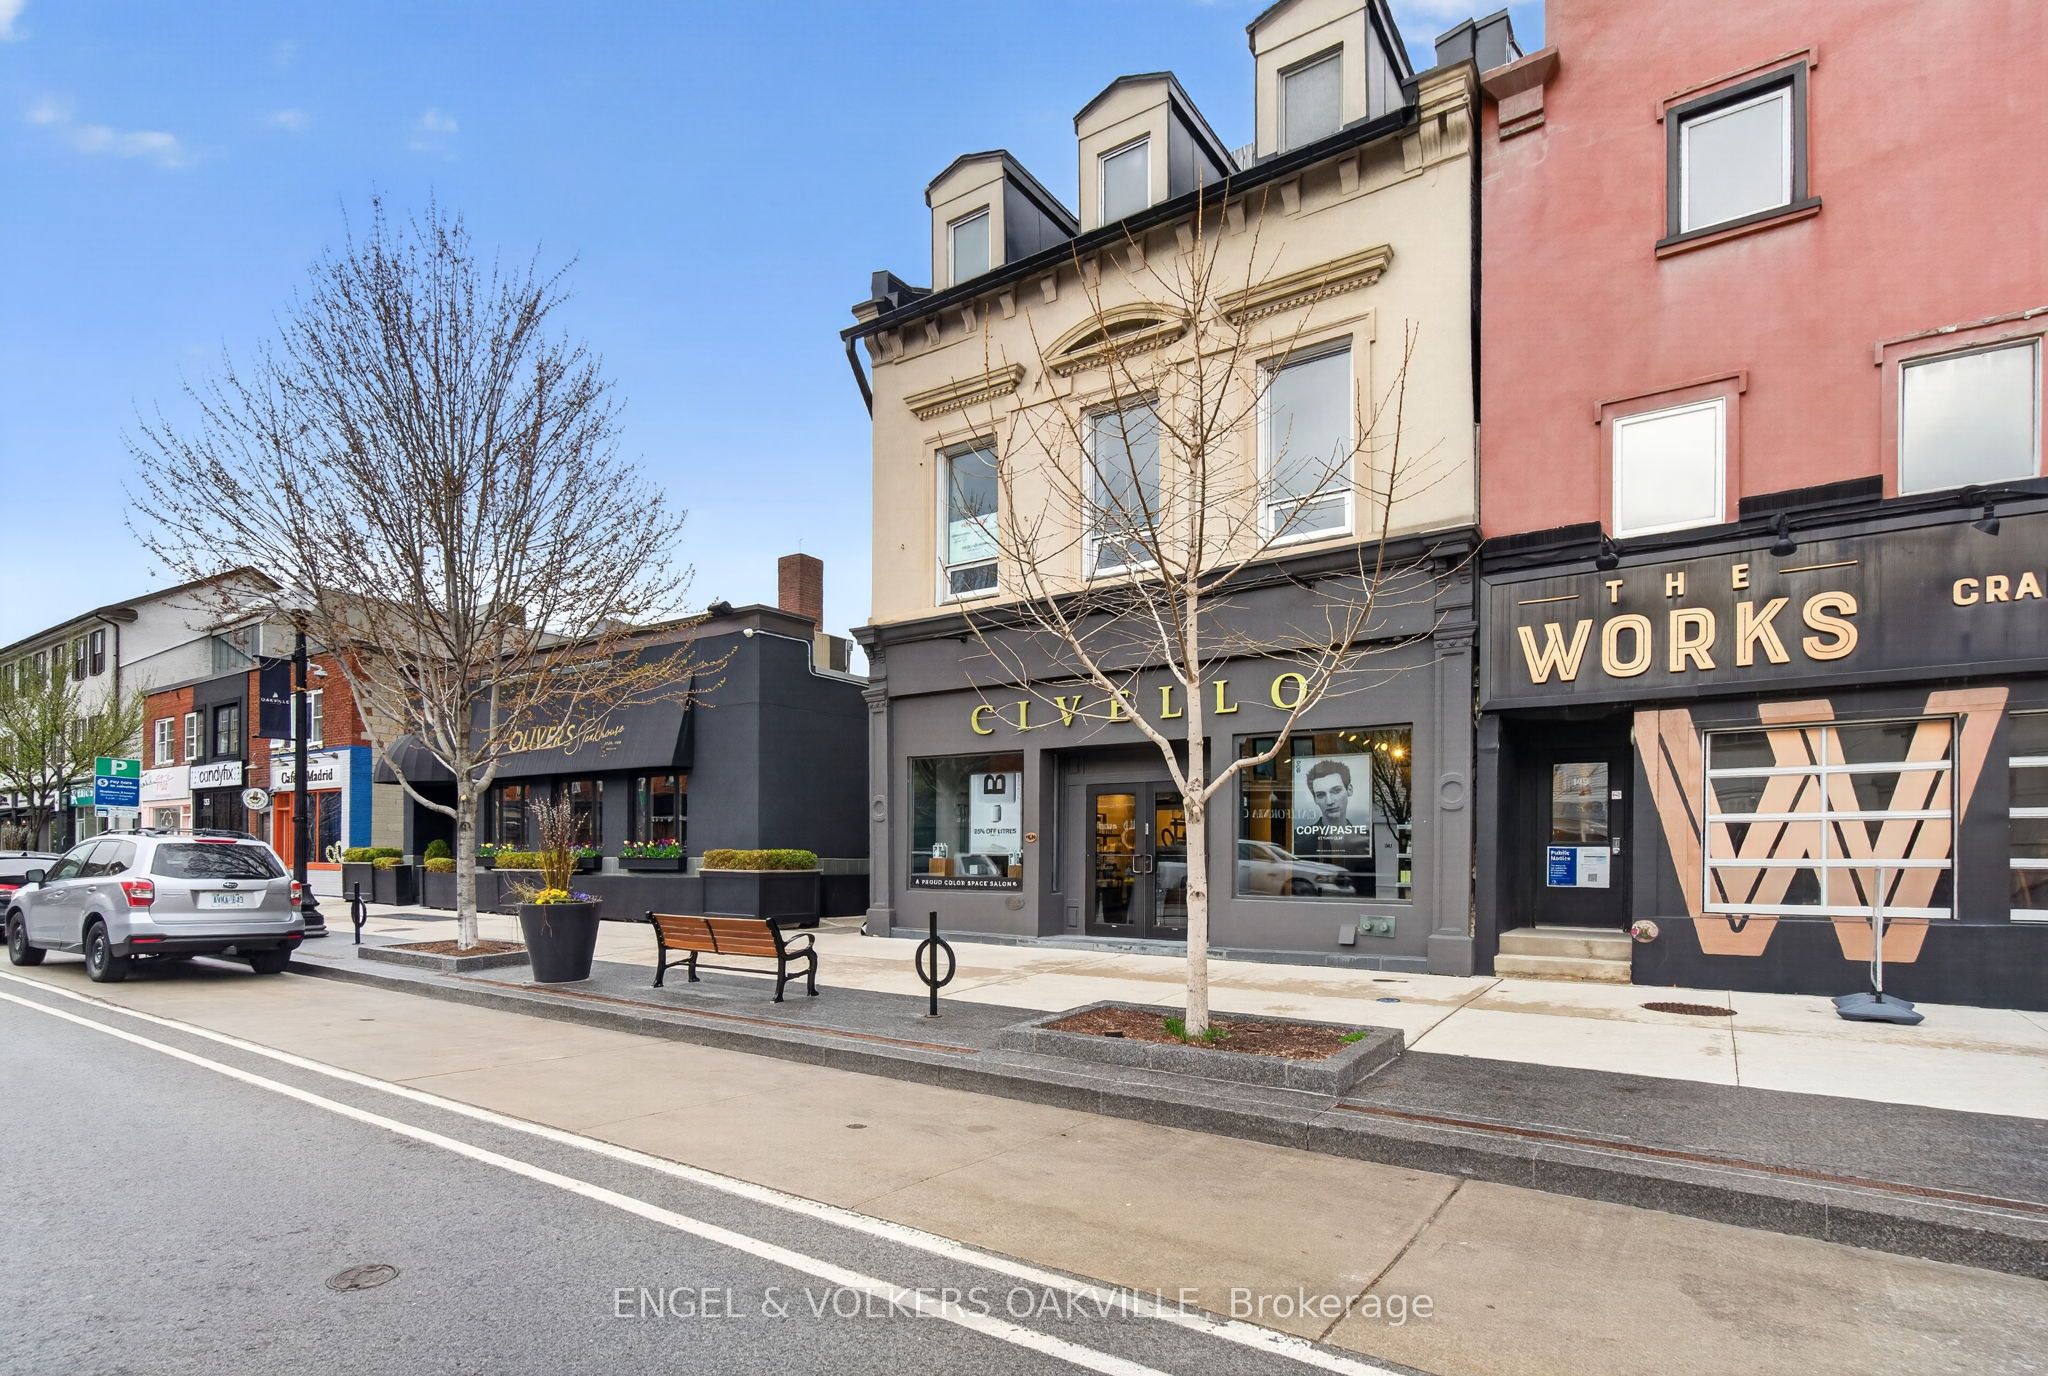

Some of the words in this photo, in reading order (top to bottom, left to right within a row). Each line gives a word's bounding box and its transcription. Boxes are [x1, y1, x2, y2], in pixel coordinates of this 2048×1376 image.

[1606, 564, 1750, 603] THE
[1517, 591, 1859, 684] WORKS
[971, 672, 1308, 735] CIVELLO
[111, 760, 128, 775] P
[199, 764, 233, 785] candyfix
[1296, 825, 1367, 836] COPY/PASTE
